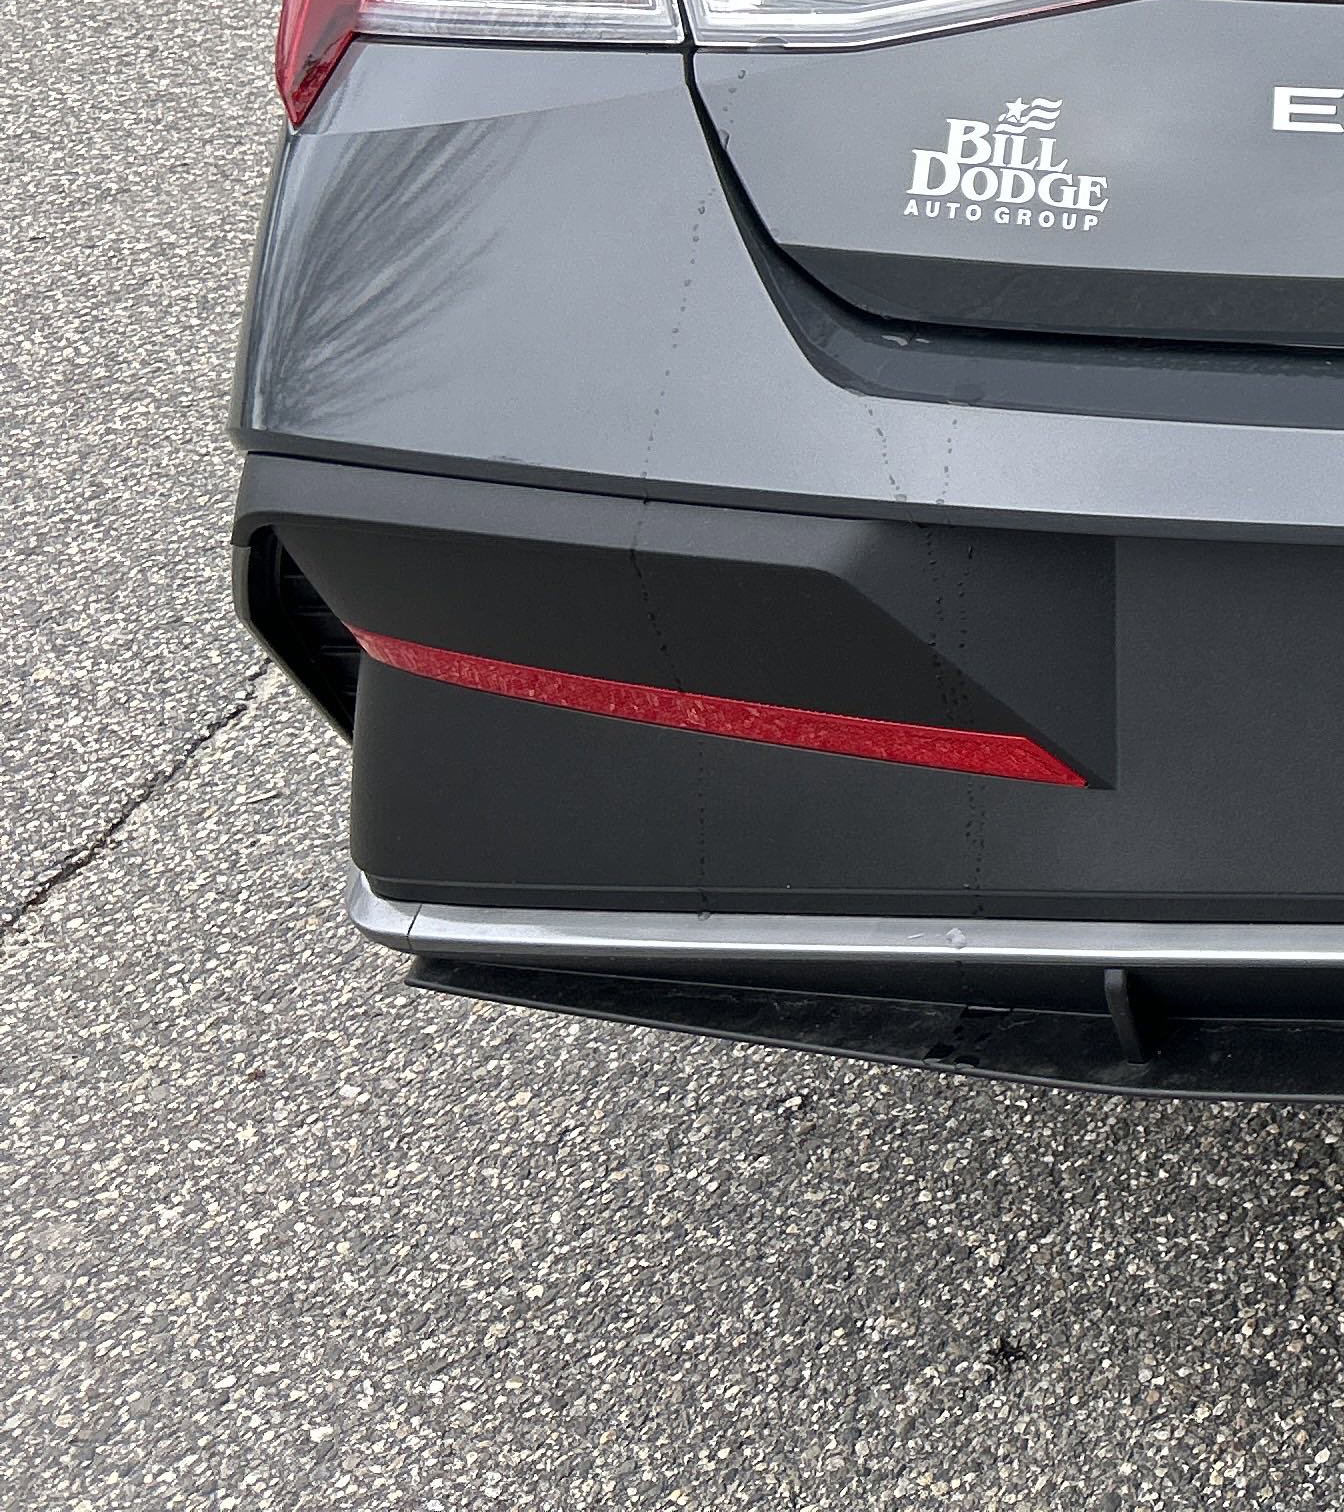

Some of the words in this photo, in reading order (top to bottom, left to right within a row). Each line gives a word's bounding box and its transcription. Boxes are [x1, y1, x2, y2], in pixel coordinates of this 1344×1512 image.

[945, 117, 1069, 173] BILL
[905, 148, 1109, 212] DODGE
[903, 198, 983, 222] AUTO
[993, 205, 1099, 232] GROUP
